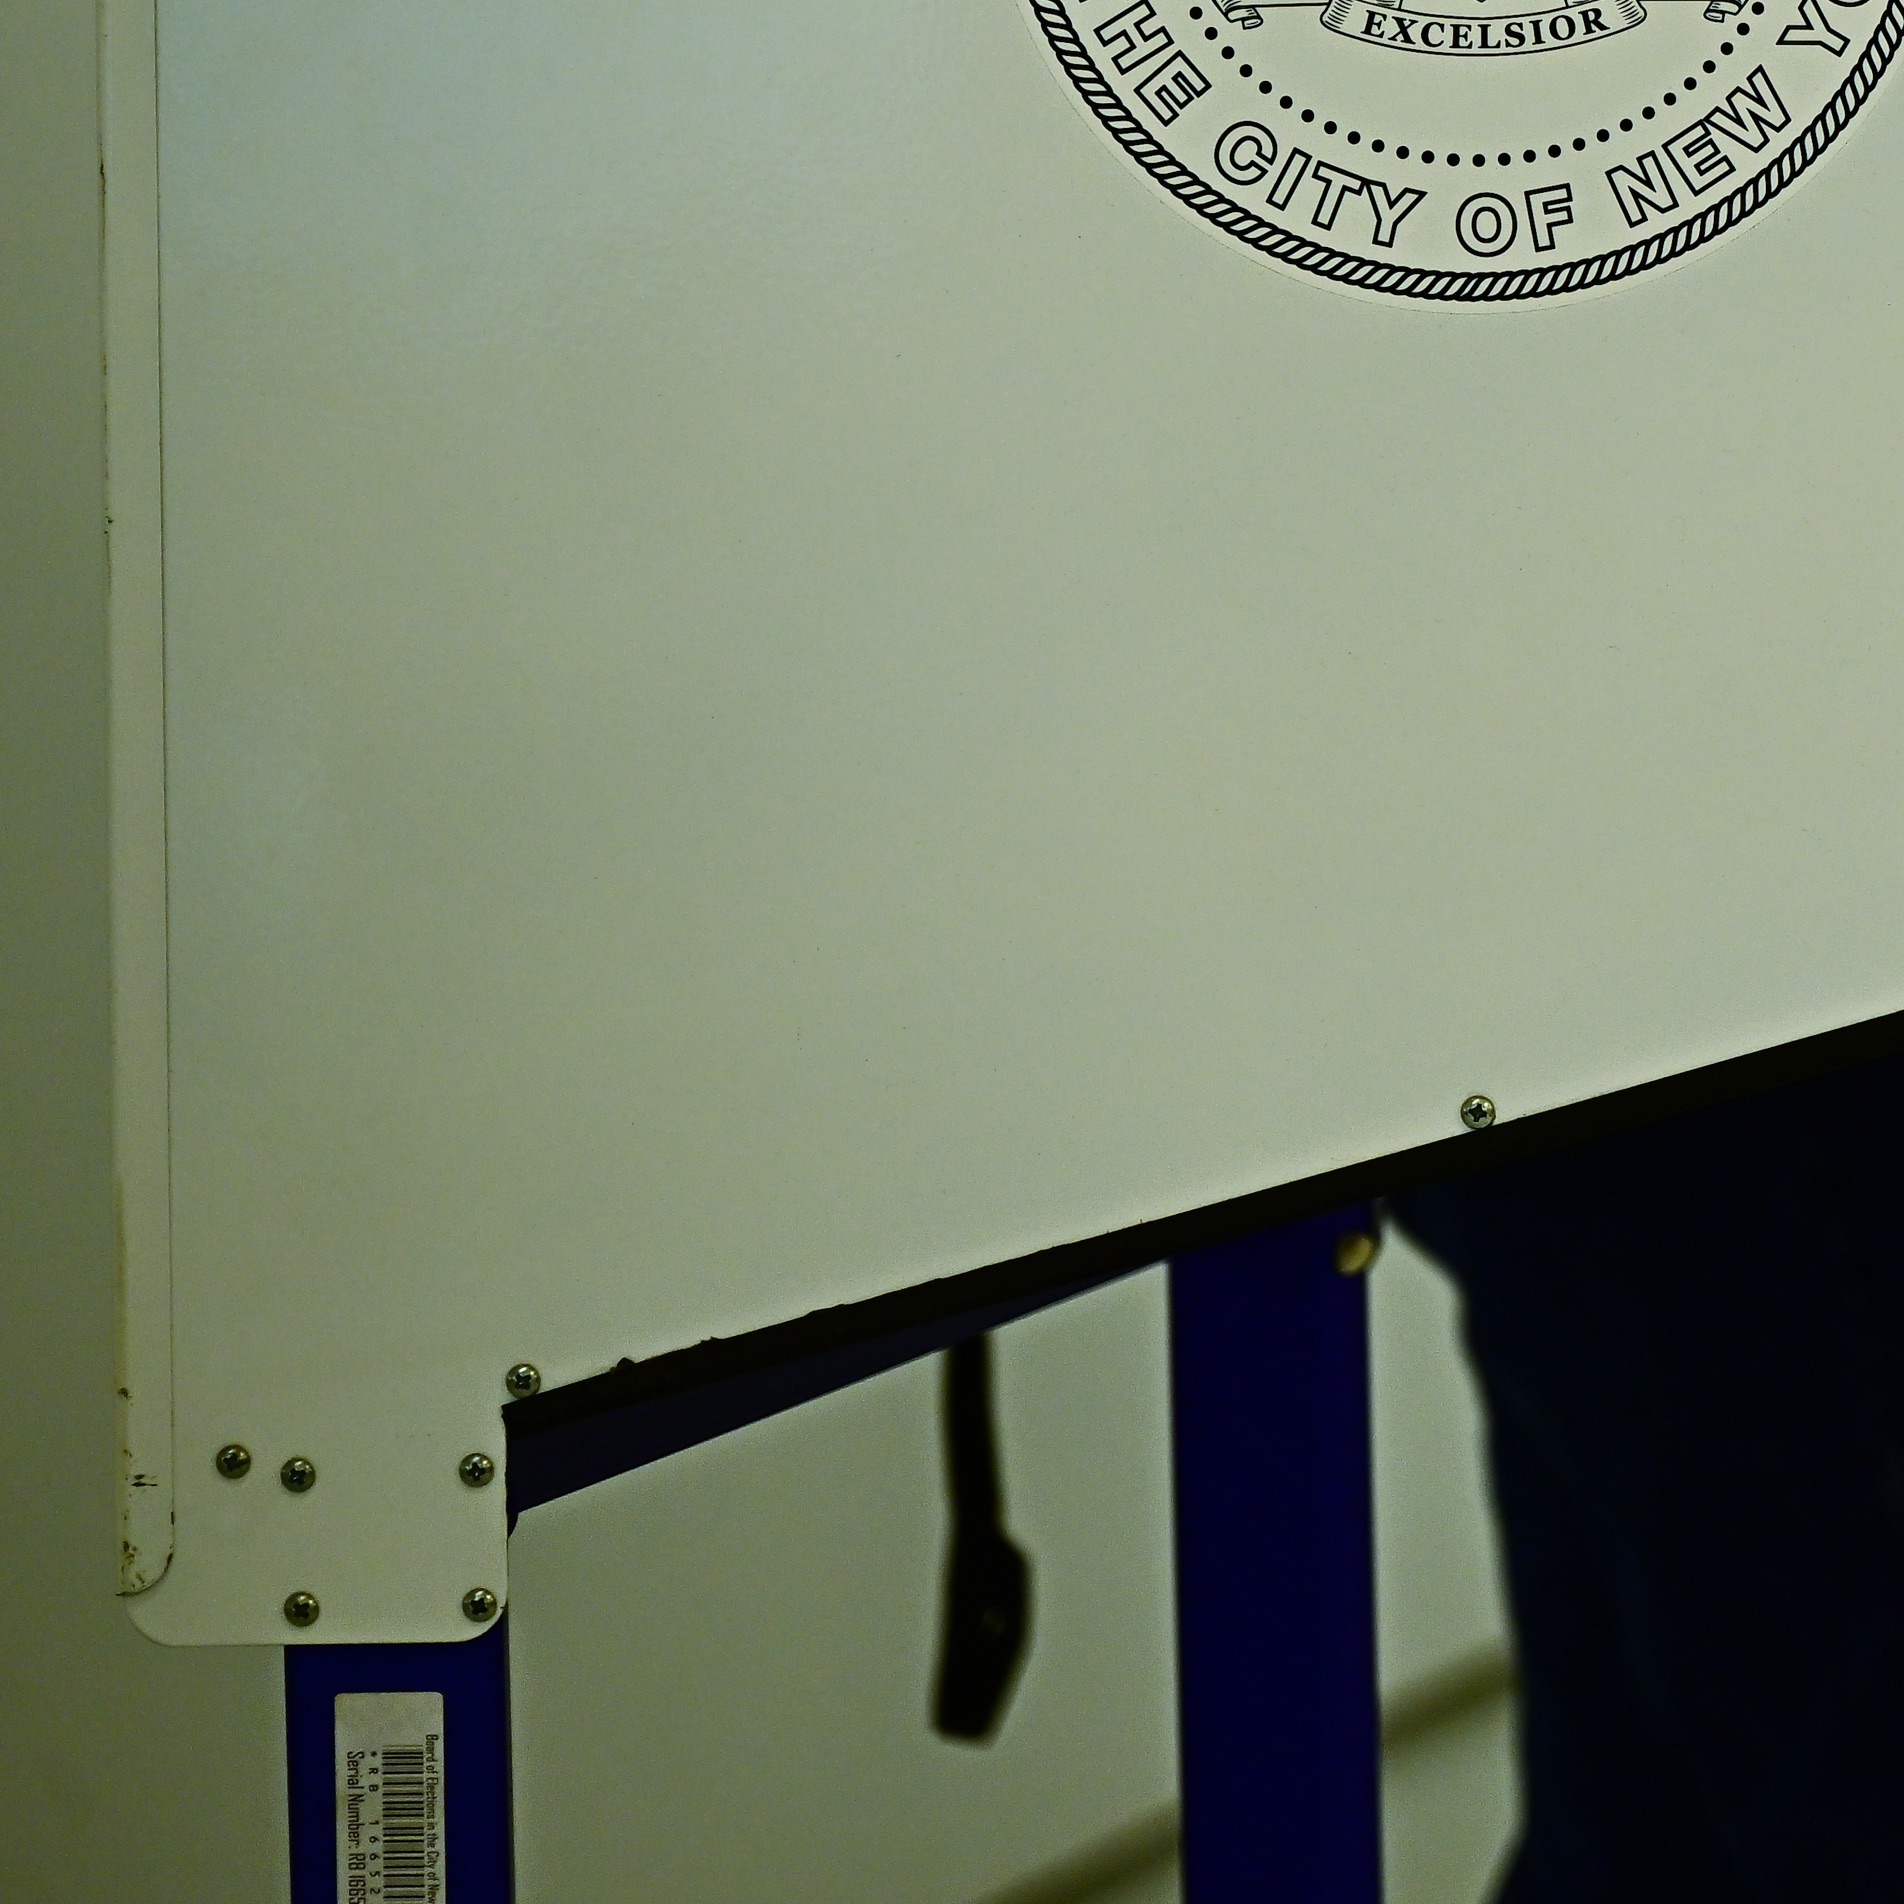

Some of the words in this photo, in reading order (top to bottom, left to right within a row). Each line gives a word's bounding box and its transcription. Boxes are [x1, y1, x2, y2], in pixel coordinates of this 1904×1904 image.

[1362, 5, 1612, 53] EXCELSIOR
[1214, 119, 1426, 249] CITY
[1453, 184, 1576, 258] OF
[1606, 65, 1795, 227] NEW
[426, 1734, 438, 1762] Board
[347, 1751, 365, 1789] Serial
[427, 1765, 438, 1775] of
[427, 1777, 438, 1820] Elections
[347, 1794, 365, 1848] Number:
[427, 1822, 438, 1831] in
[427, 1832, 438, 1848] the
[423, 1850, 440, 1869] City
[427, 1872, 438, 1882] of
